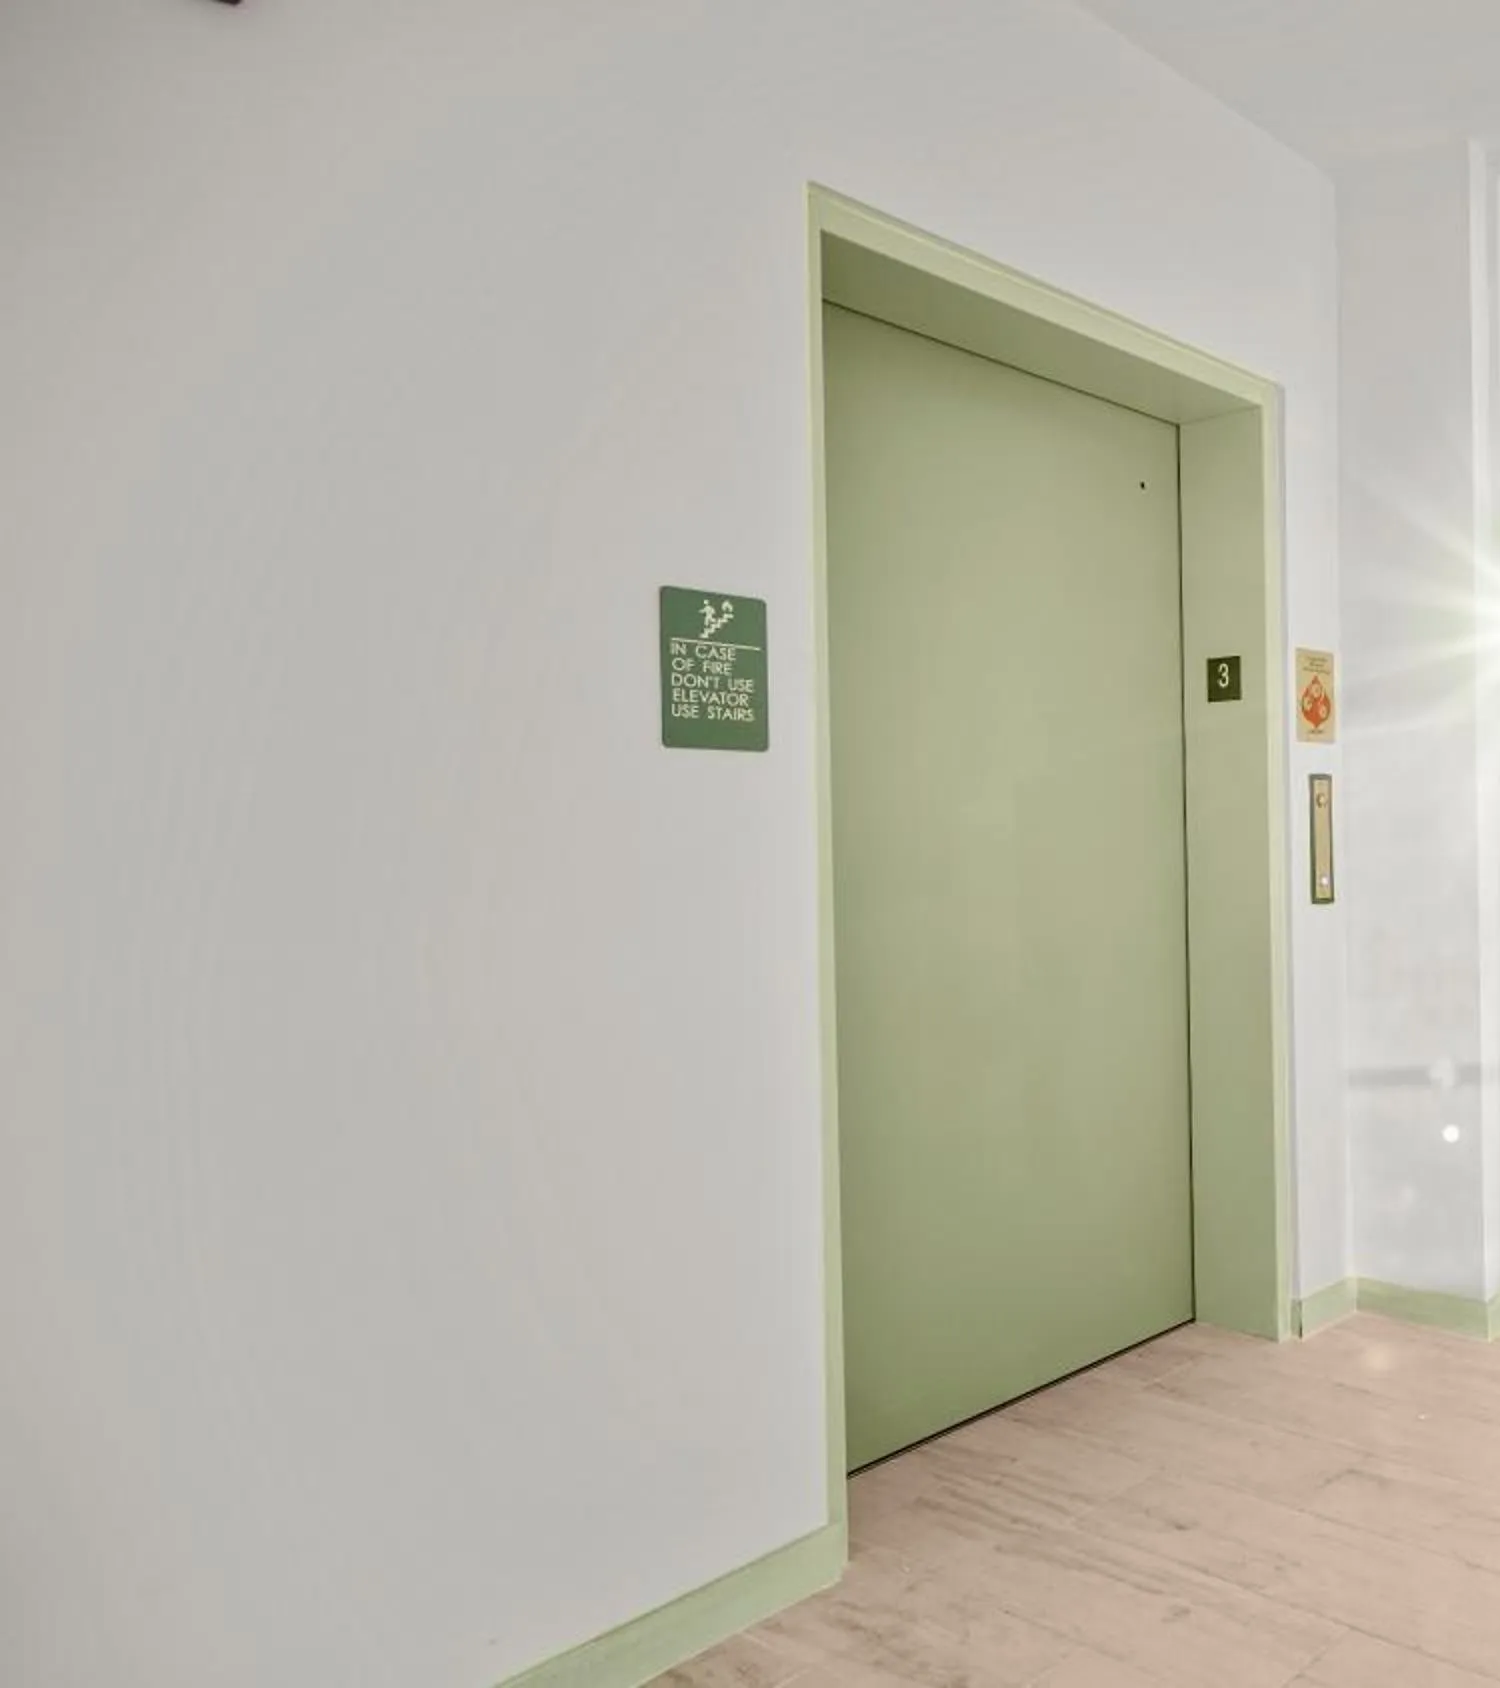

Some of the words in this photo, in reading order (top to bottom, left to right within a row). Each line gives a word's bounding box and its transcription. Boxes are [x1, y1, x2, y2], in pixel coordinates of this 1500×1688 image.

[671, 642, 687, 655] IN
[695, 645, 736, 661] CASE
[671, 657, 695, 671] OF
[702, 660, 732, 676] FIRE
[1217, 662, 1229, 688] 3
[671, 672, 720, 689] DON'T
[728, 678, 754, 693] USE
[672, 688, 749, 707] ELEVATOR
[671, 703, 700, 719] USE
[707, 705, 755, 721] STAIRS
